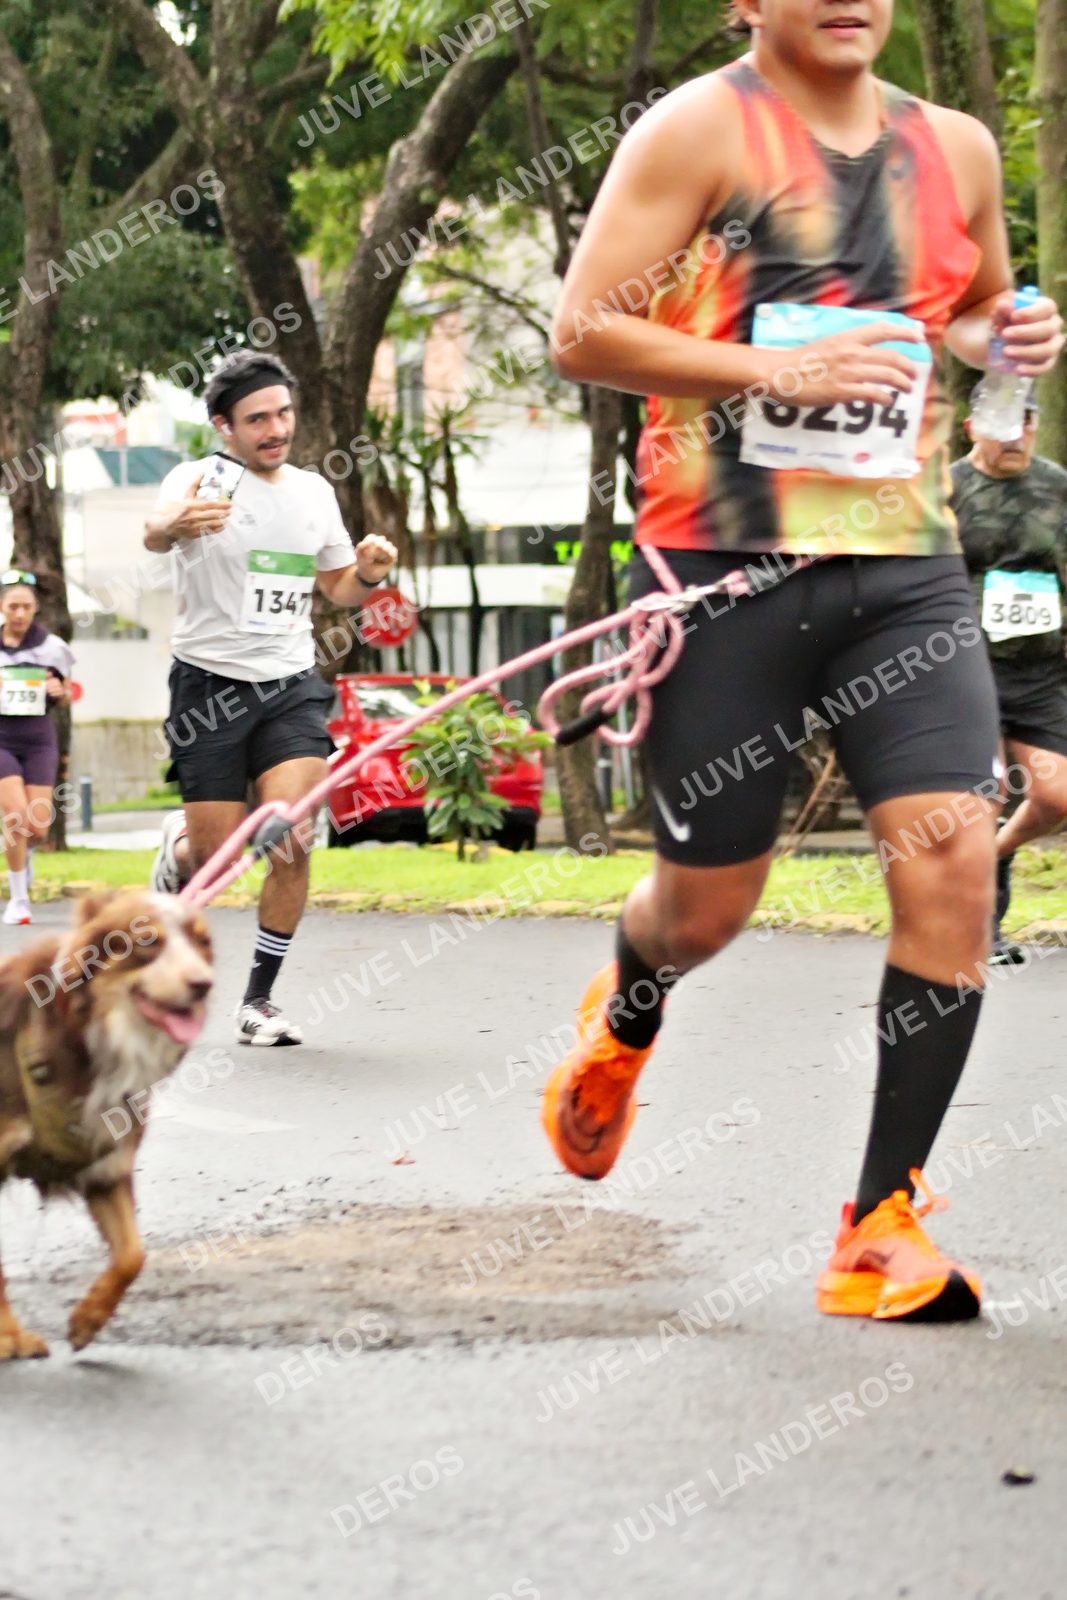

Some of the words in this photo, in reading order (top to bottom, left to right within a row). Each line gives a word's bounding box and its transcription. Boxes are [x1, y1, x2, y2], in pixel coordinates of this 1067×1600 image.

[254, 588, 312, 616] 1347
[991, 603, 1052, 626] 3809
[7, 690, 37, 703] 739
